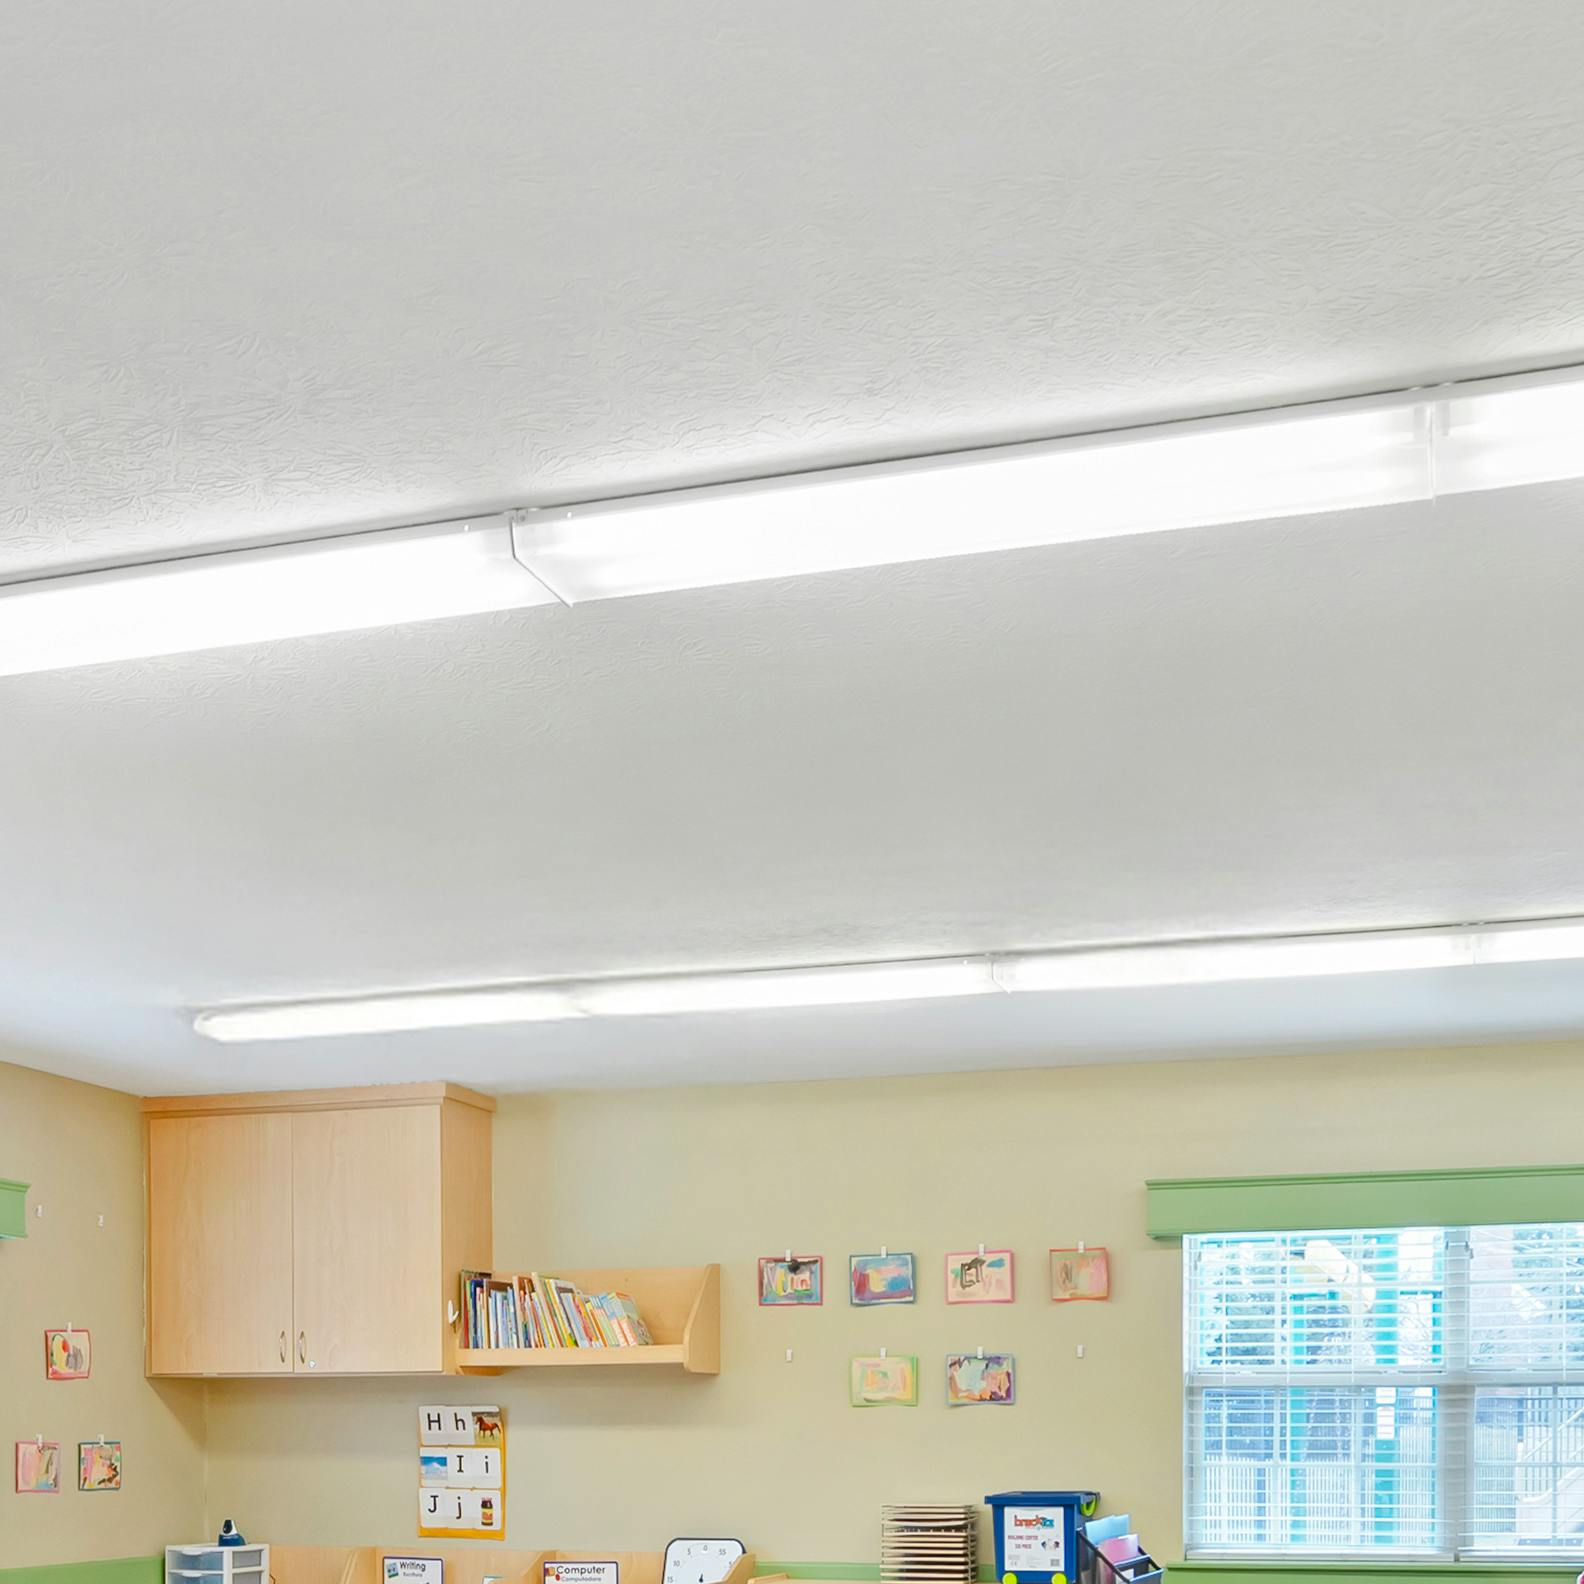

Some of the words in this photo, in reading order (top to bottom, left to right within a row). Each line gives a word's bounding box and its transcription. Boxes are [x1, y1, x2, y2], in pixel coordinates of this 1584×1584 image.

[427, 1413, 442, 1431] H
[454, 1412, 466, 1431] h
[456, 1455, 464, 1473] I
[485, 1455, 489, 1473] i
[428, 1495, 439, 1513] J
[456, 1496, 462, 1520] j
[400, 1561, 426, 1572] Writing
[556, 1565, 606, 1576] Computer
